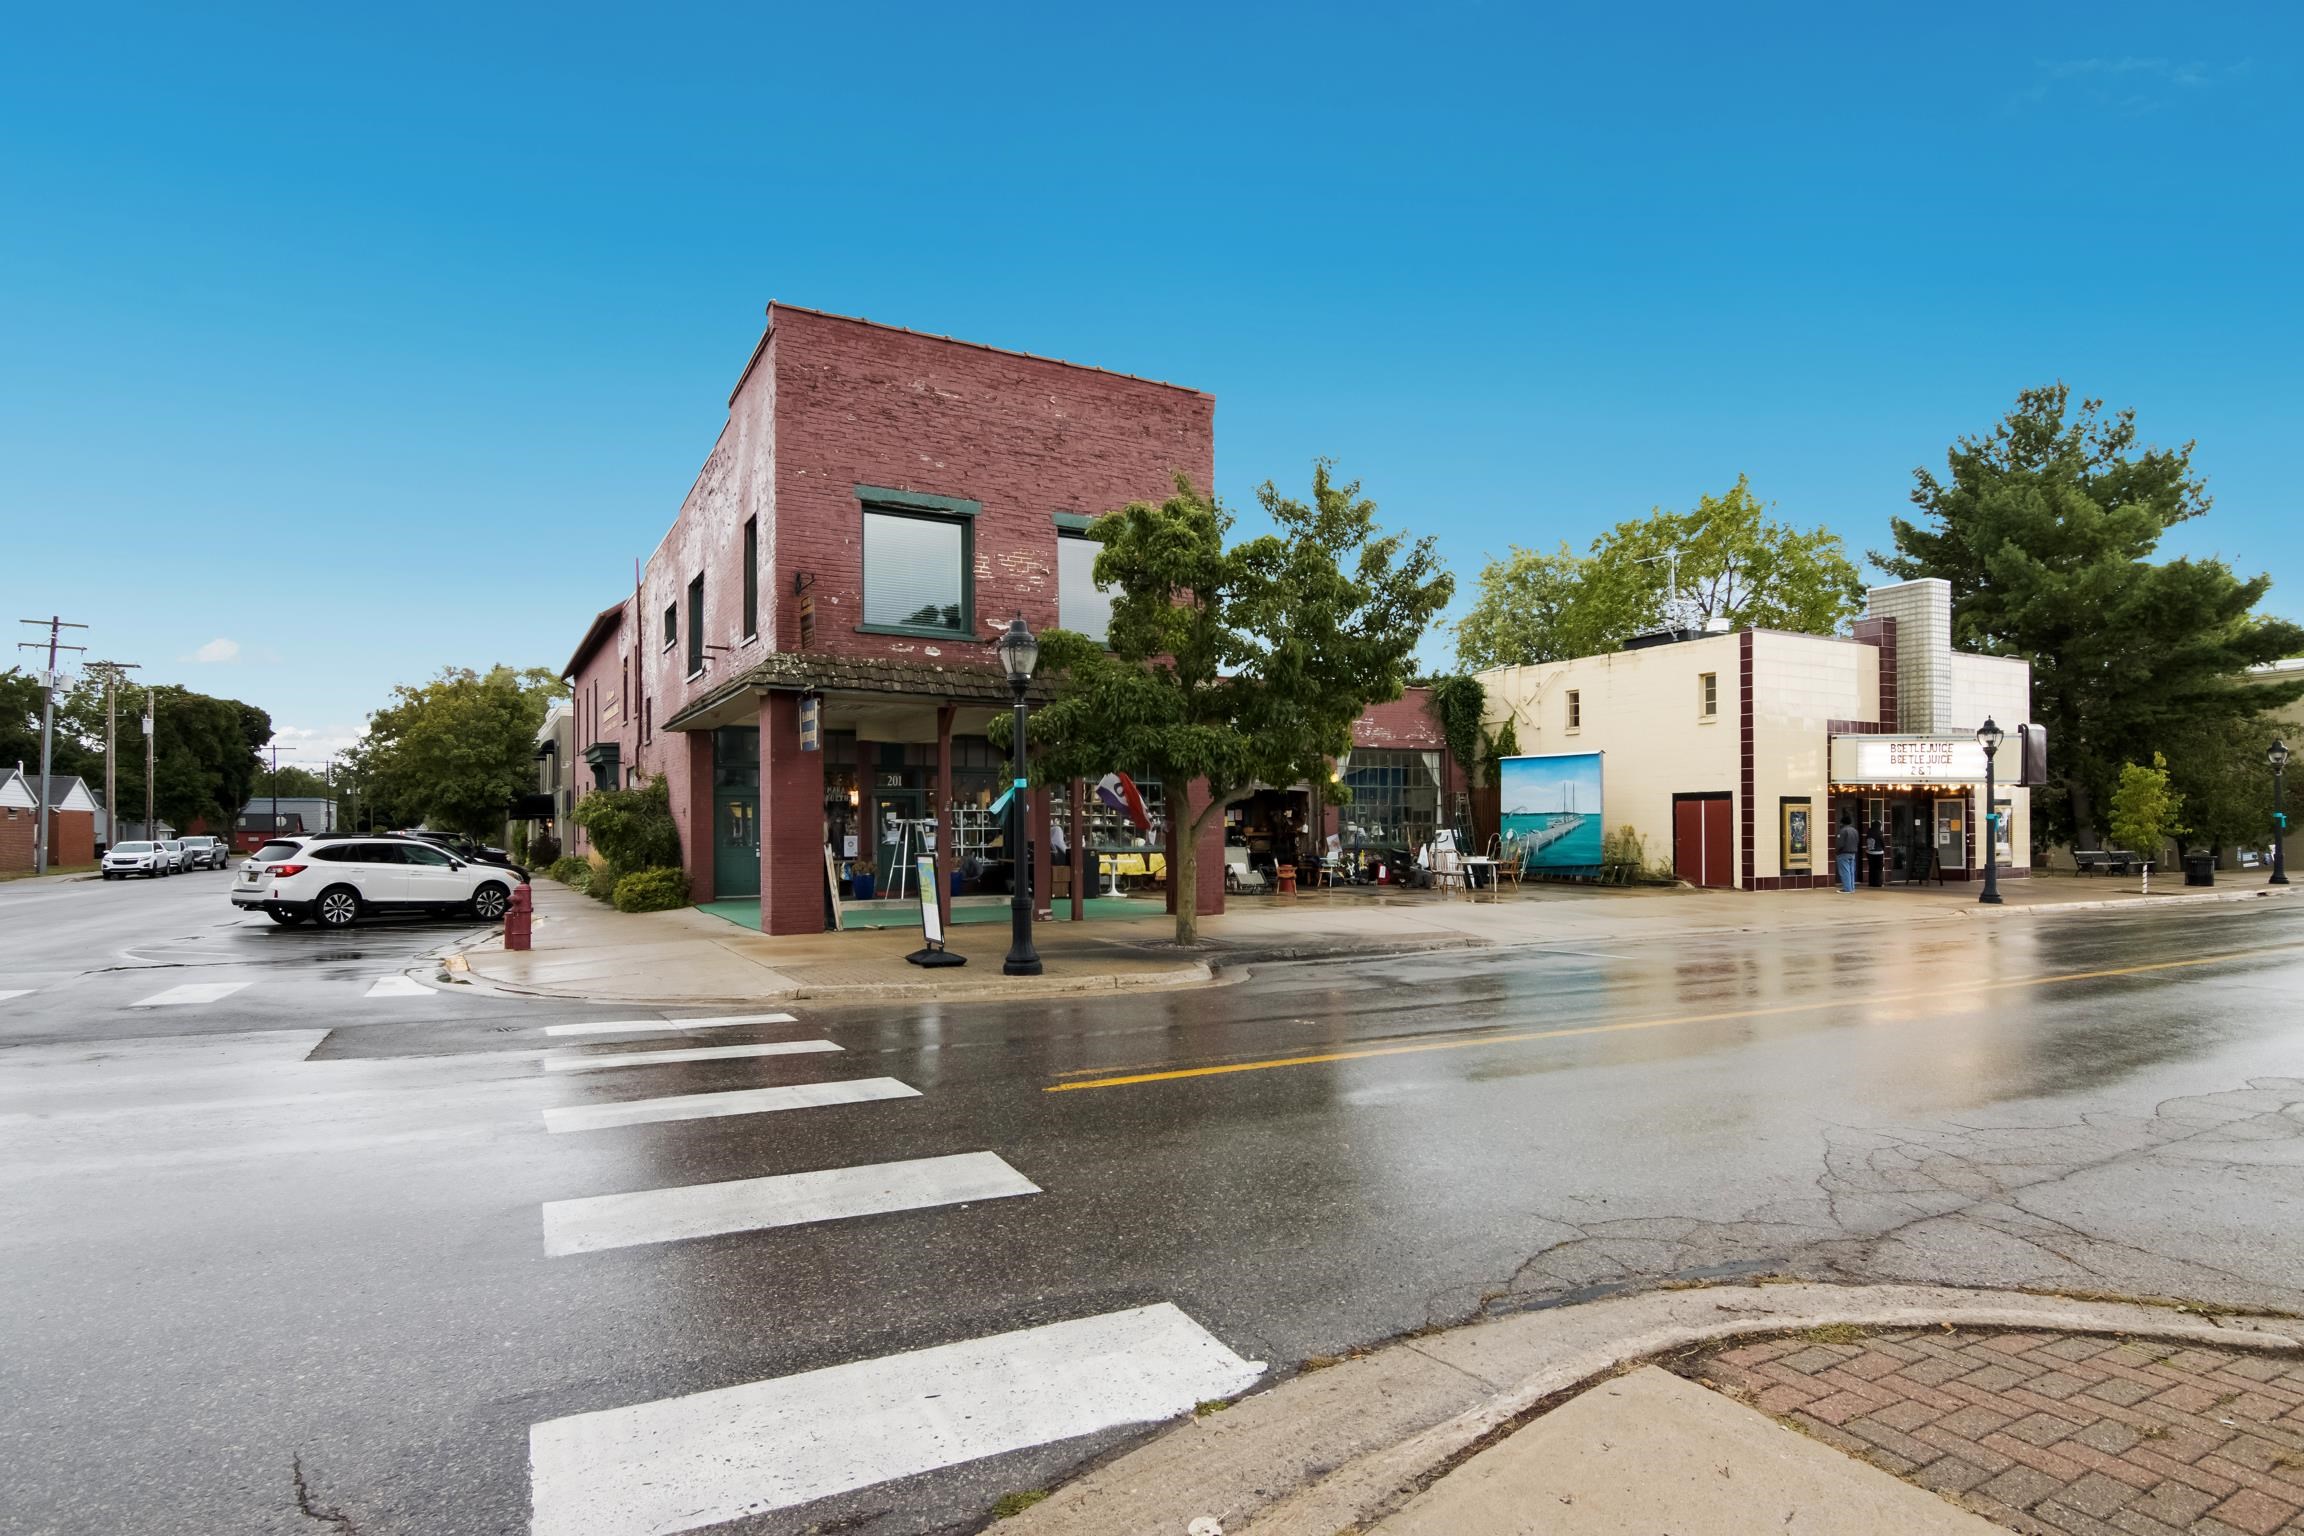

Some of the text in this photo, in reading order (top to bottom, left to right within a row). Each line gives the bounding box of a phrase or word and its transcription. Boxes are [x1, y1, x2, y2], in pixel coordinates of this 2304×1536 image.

[1890, 743, 1954, 753] BEETLEJUICE
[1890, 754, 1952, 764] BEETLEJUICE
[887, 775, 902, 786] 201
